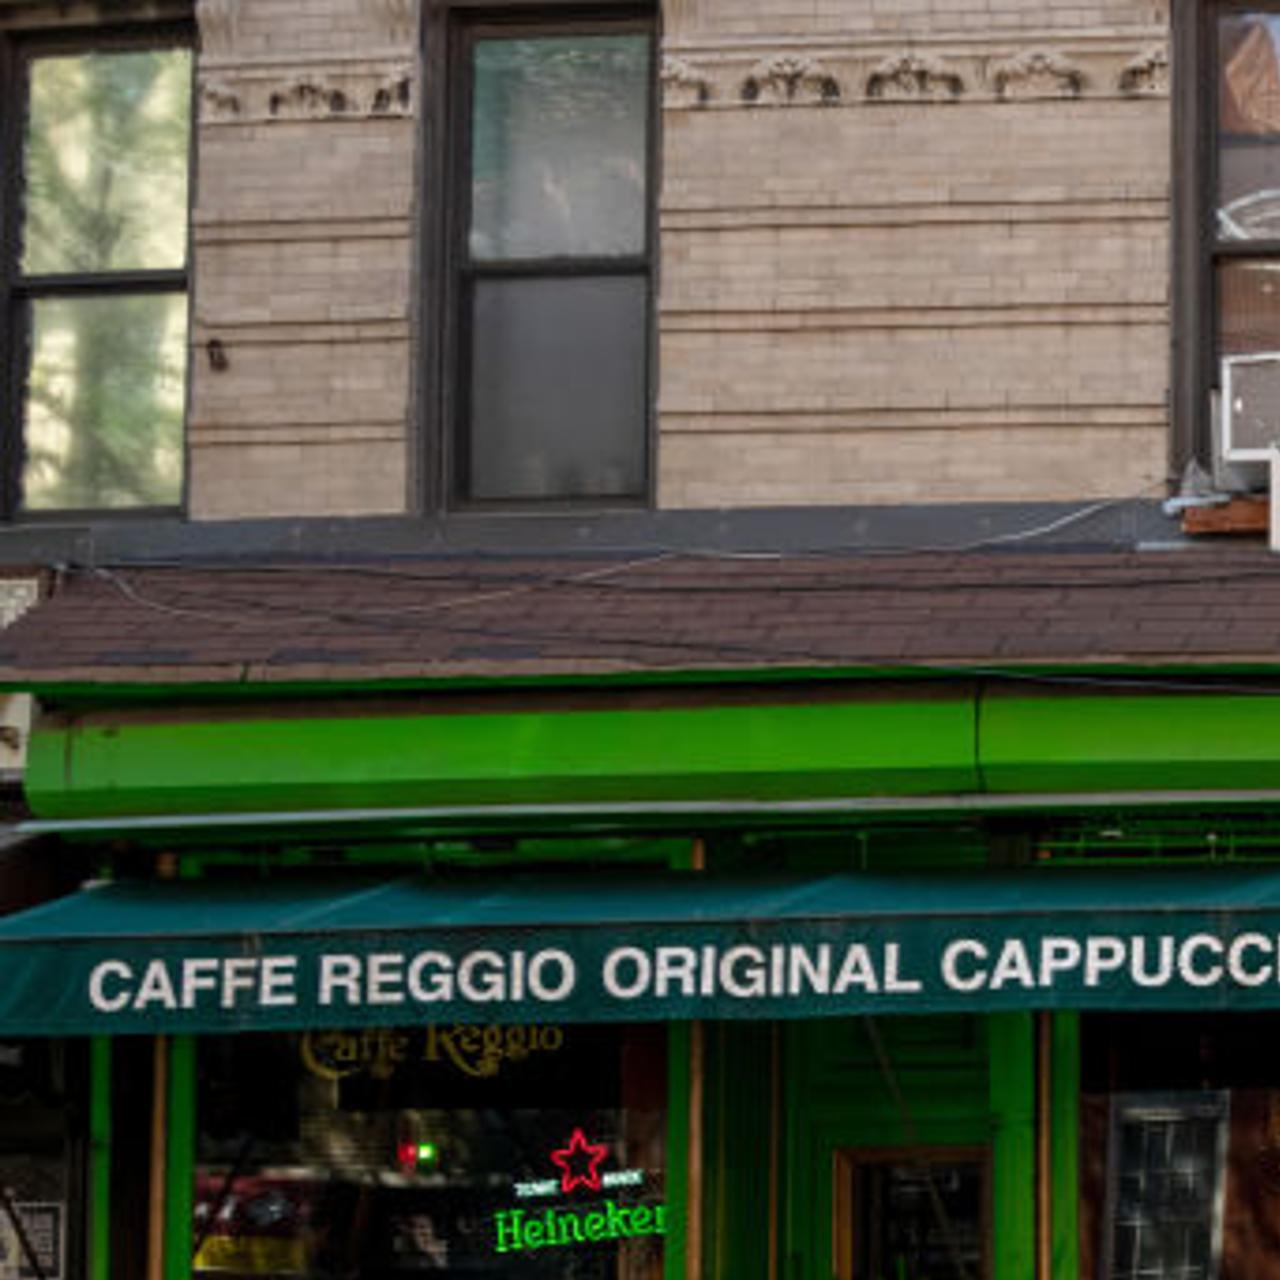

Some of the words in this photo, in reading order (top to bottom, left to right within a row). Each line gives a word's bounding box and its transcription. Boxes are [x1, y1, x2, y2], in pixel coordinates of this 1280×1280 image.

[88, 956, 299, 1013] CAFFE
[316, 948, 577, 1005] REGGIO
[600, 941, 922, 997] ORIGINAL
